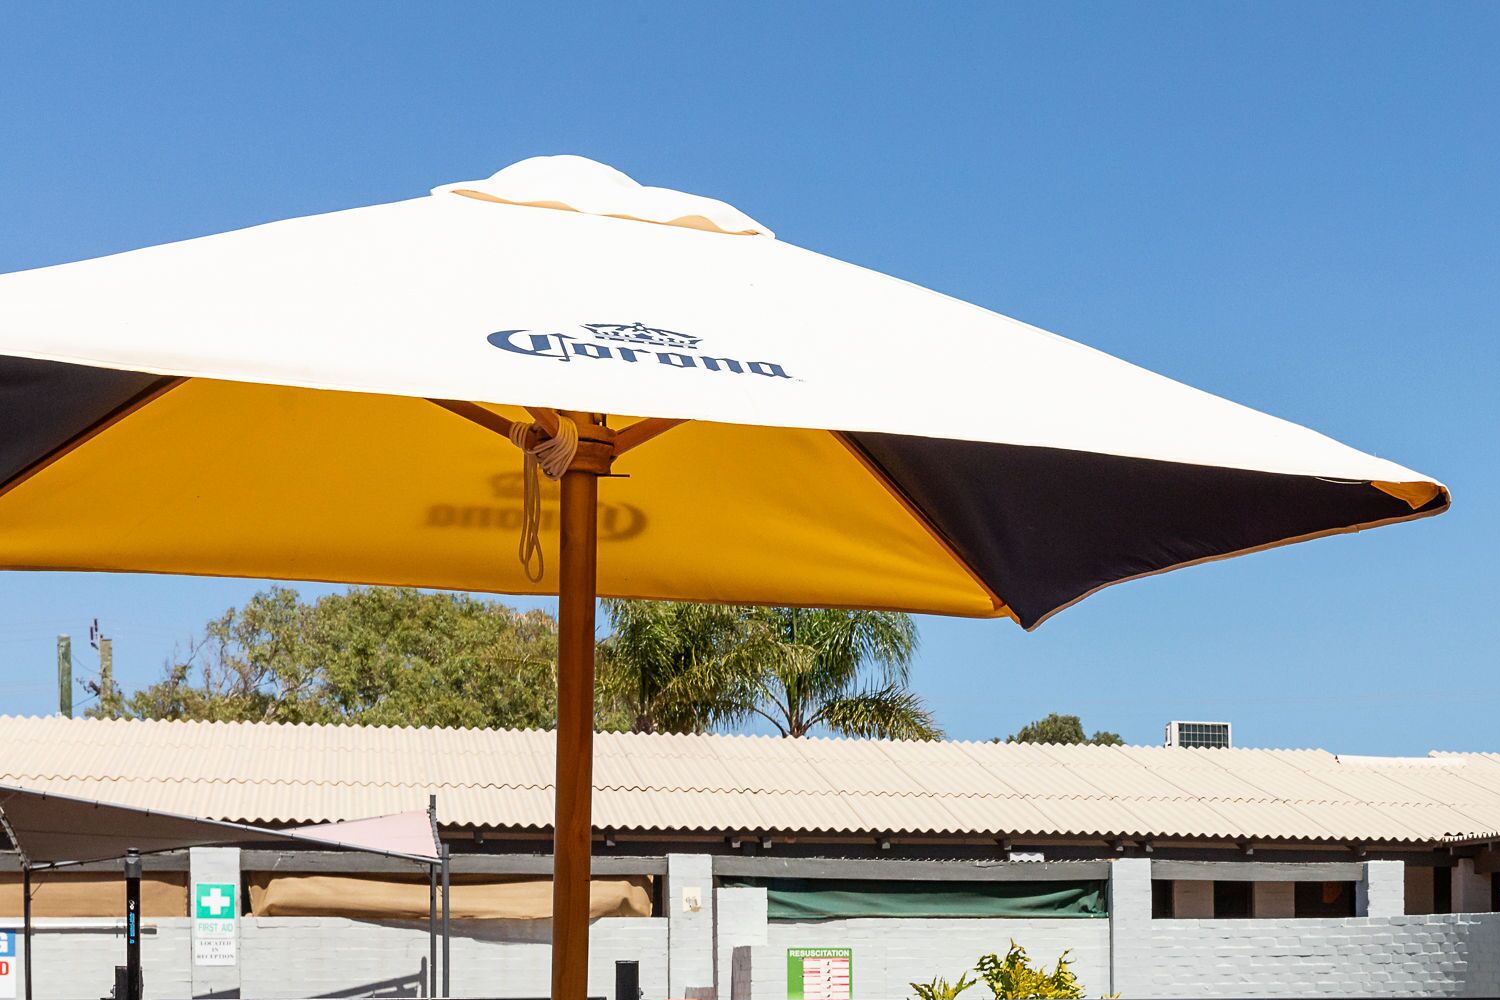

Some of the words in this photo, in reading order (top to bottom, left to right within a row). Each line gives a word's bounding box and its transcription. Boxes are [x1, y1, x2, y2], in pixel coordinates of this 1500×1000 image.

[486, 328, 793, 379] Corona
[198, 923, 218, 931] FIRST
[790, 949, 850, 957] RESUSCITATION
